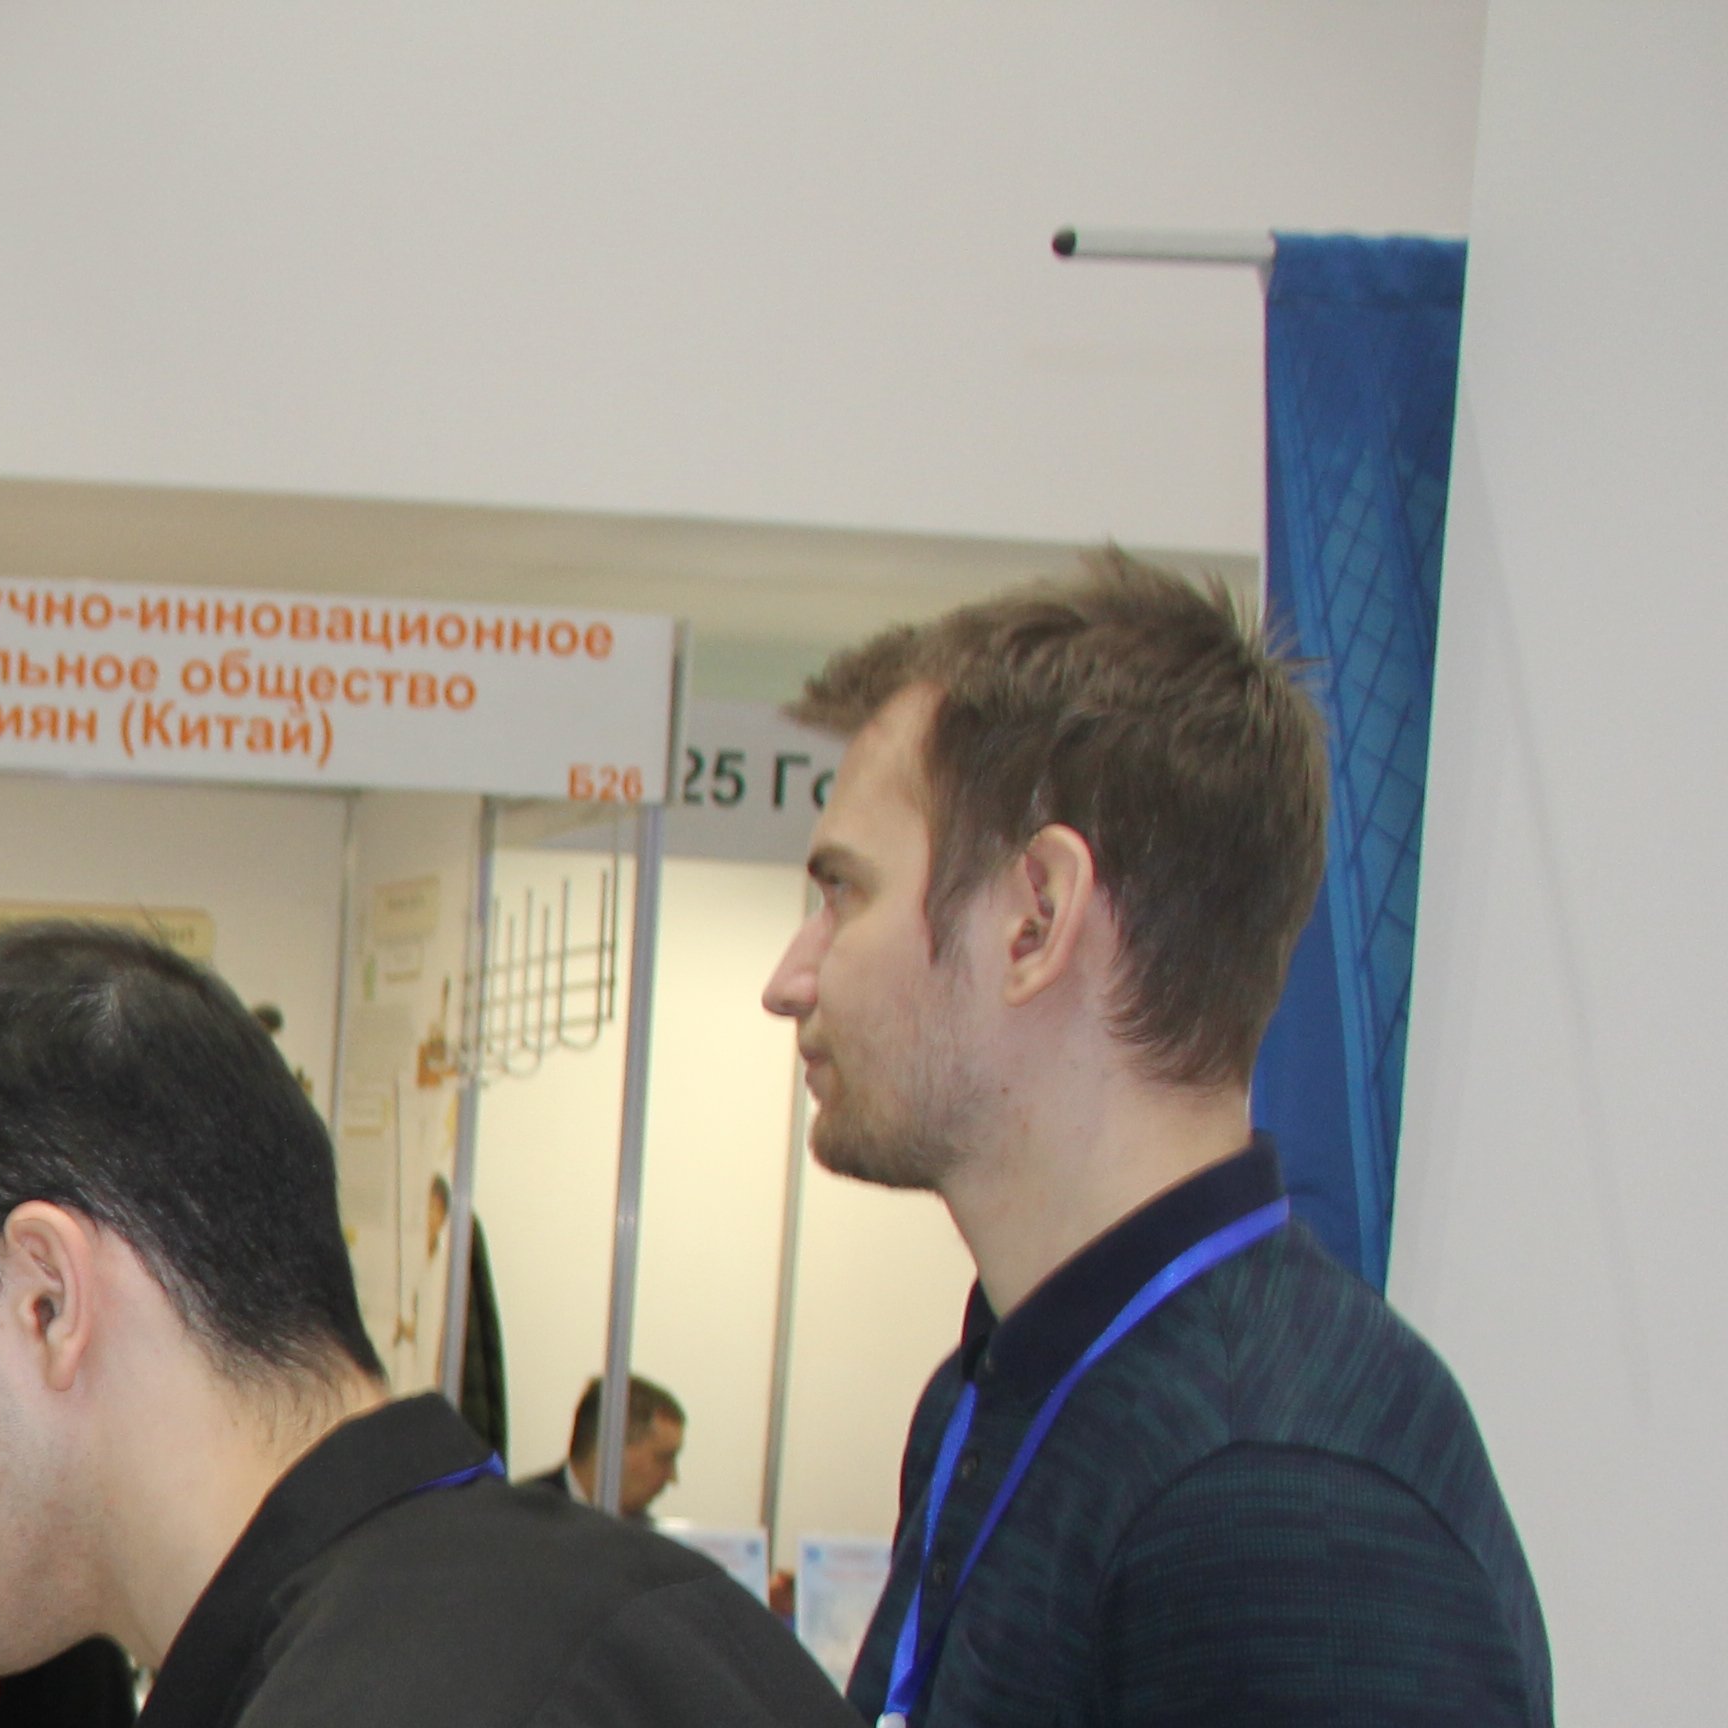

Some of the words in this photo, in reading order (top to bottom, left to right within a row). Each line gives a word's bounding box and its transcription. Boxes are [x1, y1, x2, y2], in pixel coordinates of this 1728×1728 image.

[180, 648, 478, 712] общество
[119, 698, 334, 769] (Китай)
[567, 763, 643, 803] Б26
